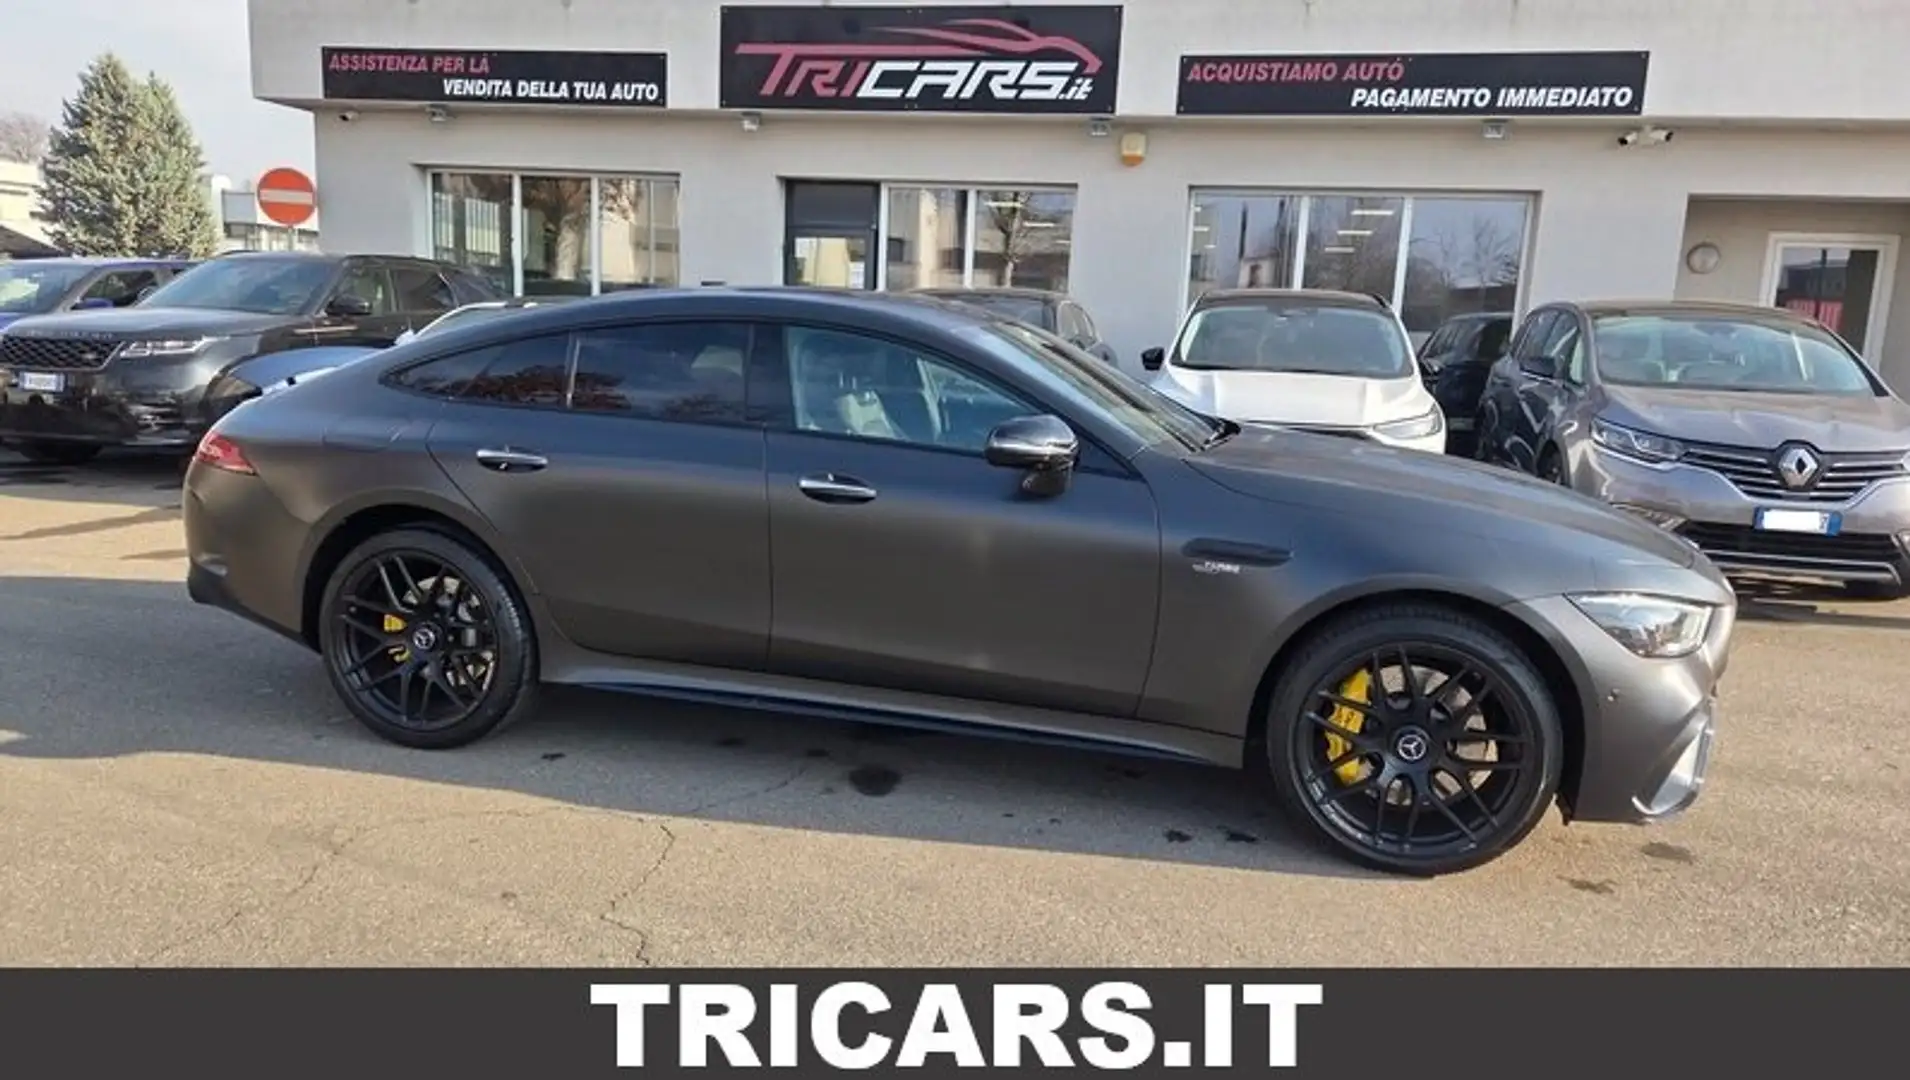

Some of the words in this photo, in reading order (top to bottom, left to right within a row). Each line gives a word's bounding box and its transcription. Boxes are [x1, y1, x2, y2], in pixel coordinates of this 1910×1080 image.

[329, 52, 427, 72] ASSISTENZA
[432, 55, 465, 73] PER
[1186, 63, 1337, 82] ACQUISTIAMO
[443, 79, 512, 97] VENDITA
[516, 80, 569, 99] DELLA
[574, 83, 606, 100] TUA
[611, 84, 659, 101] AUTO
[1350, 88, 1491, 107] PAGAMENTO
[1496, 87, 1633, 107] IMMEDIATO
